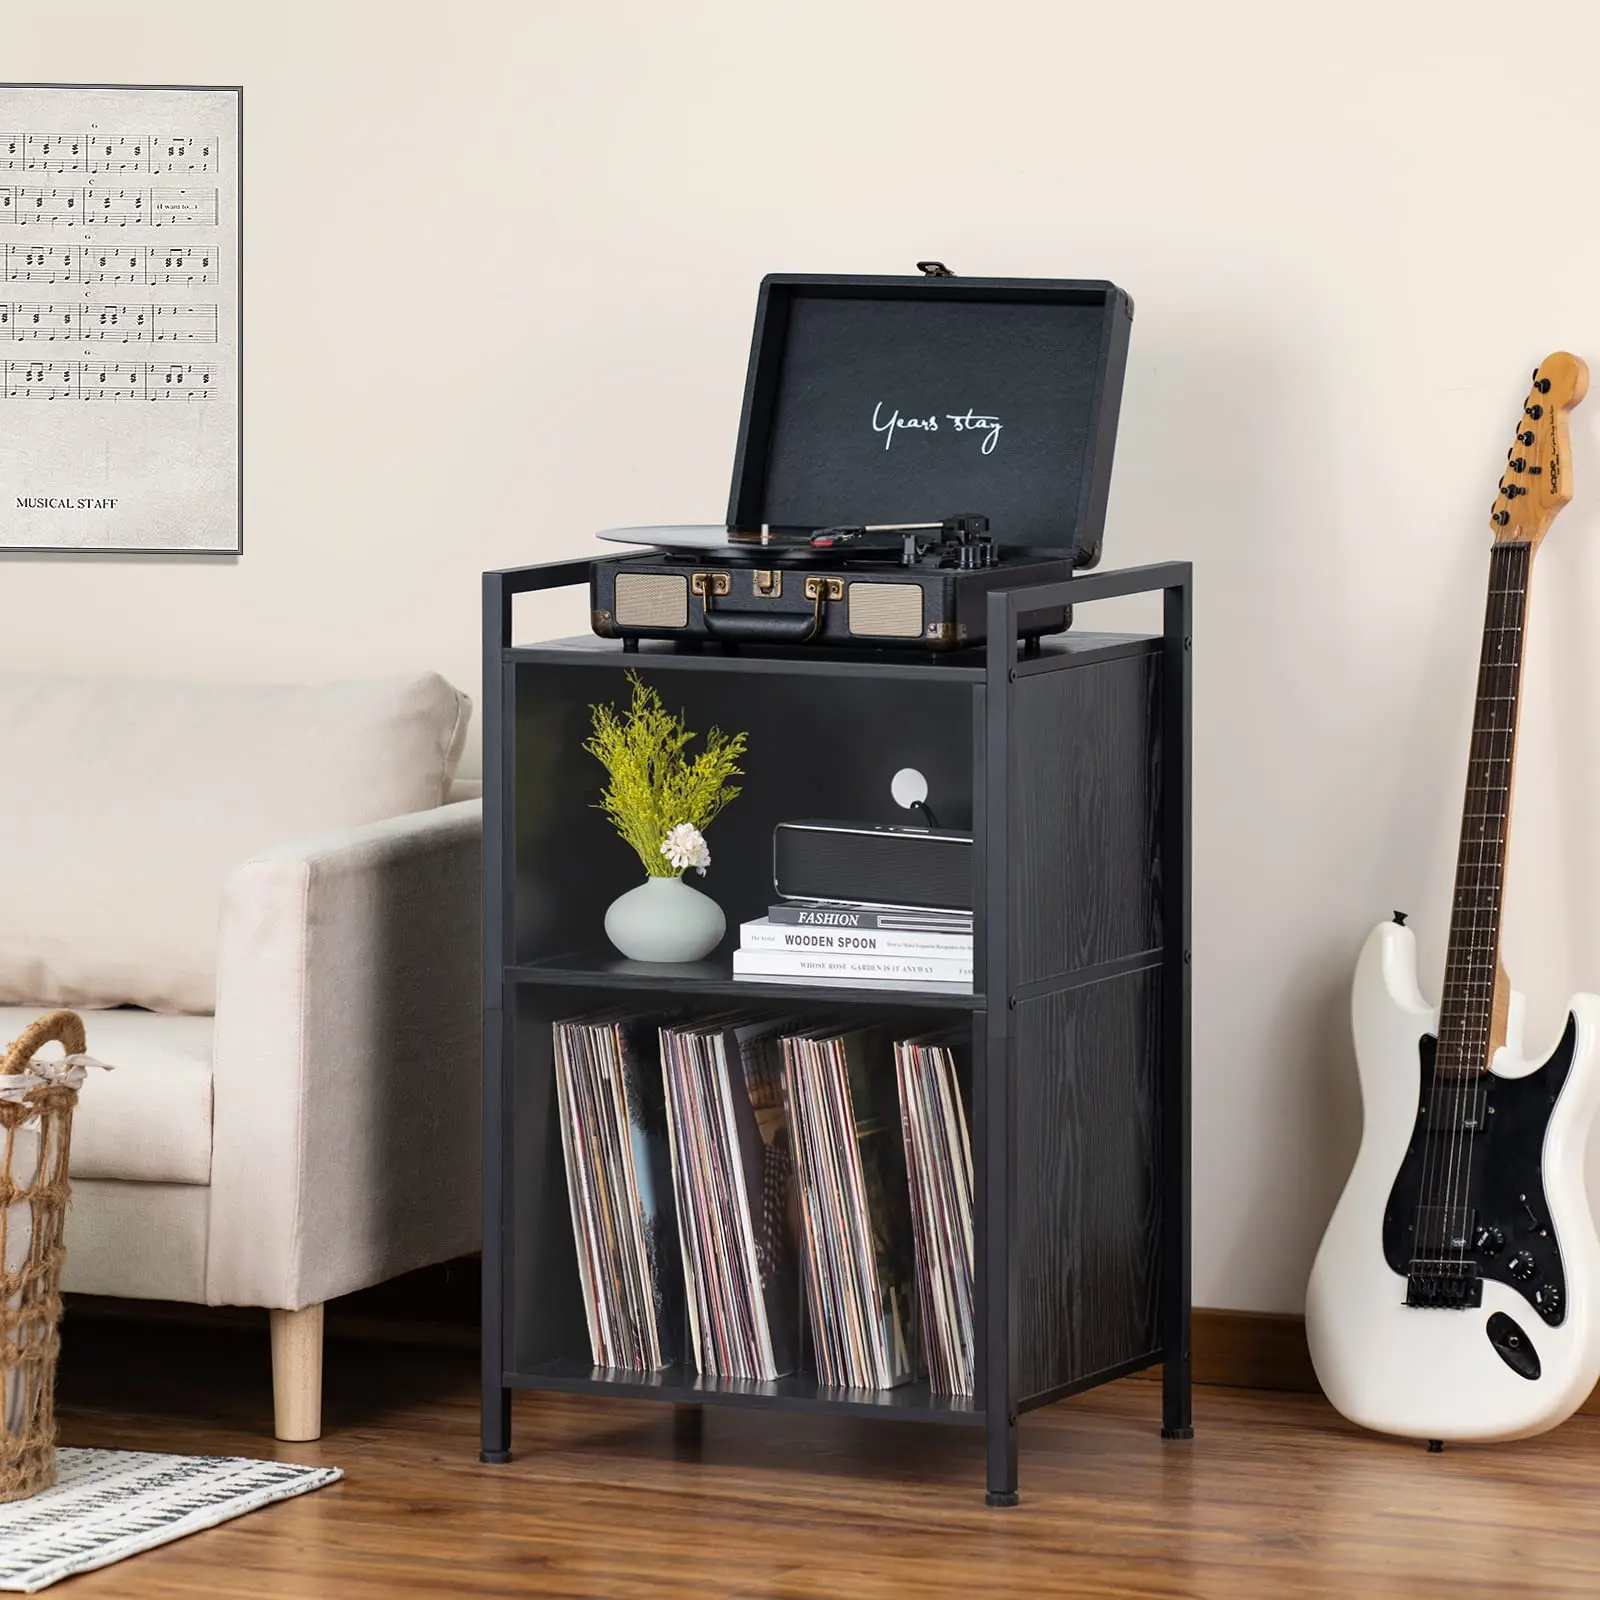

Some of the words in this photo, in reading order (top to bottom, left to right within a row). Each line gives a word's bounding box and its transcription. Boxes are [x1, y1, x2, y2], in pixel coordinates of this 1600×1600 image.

[945, 408, 1004, 455] stay
[16, 497, 75, 509] MUSICAL
[77, 498, 119, 509] STAFF
[798, 912, 860, 926] FASHION
[784, 935, 834, 947] WOODEN
[838, 937, 877, 949] SPOON
